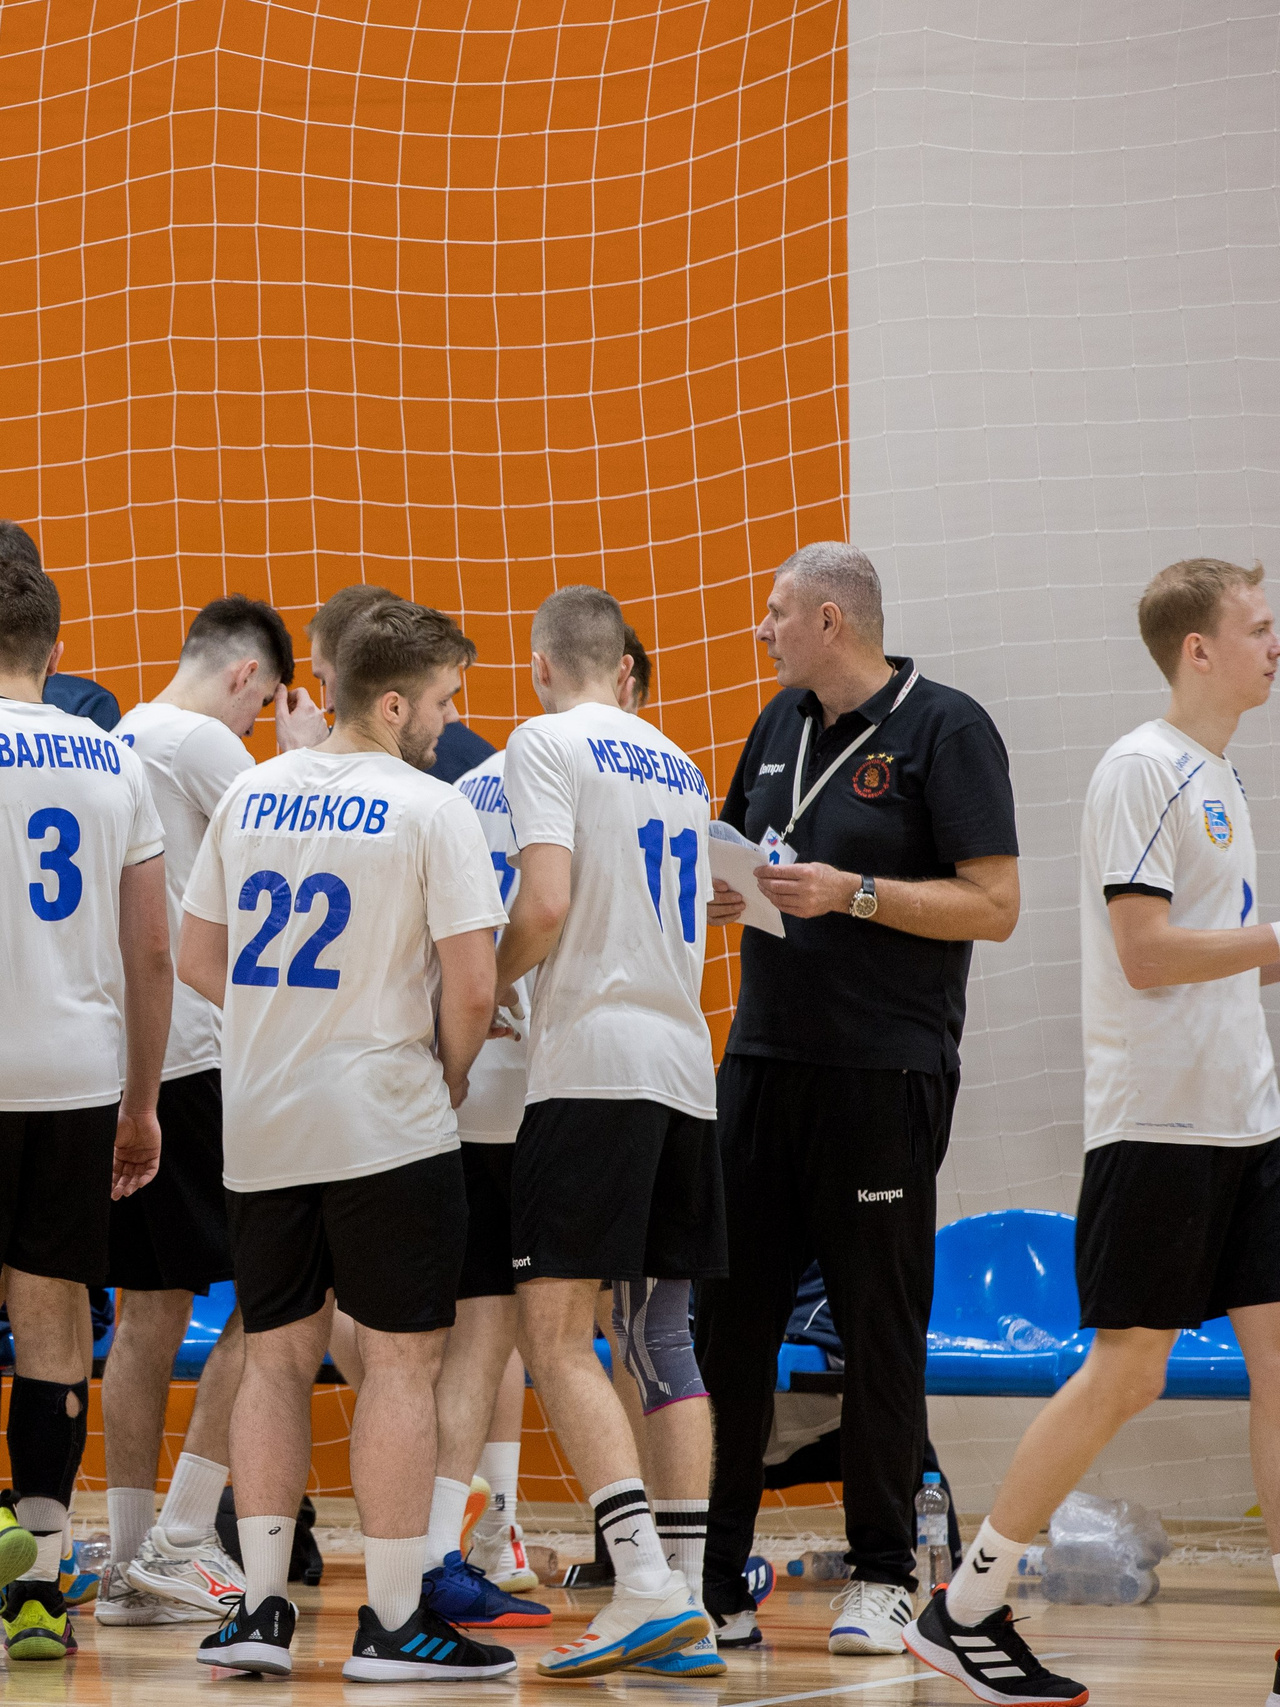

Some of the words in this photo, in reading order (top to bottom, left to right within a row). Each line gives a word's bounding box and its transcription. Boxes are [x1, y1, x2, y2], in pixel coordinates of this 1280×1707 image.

[241, 793, 389, 834] ГРИБКОВ
[587, 737, 709, 803] МЕДВЕДКОВ
[28, 807, 83, 922] 3
[637, 818, 698, 944] 11
[232, 870, 351, 990] 22
[857, 1188, 904, 1204] Kempa
